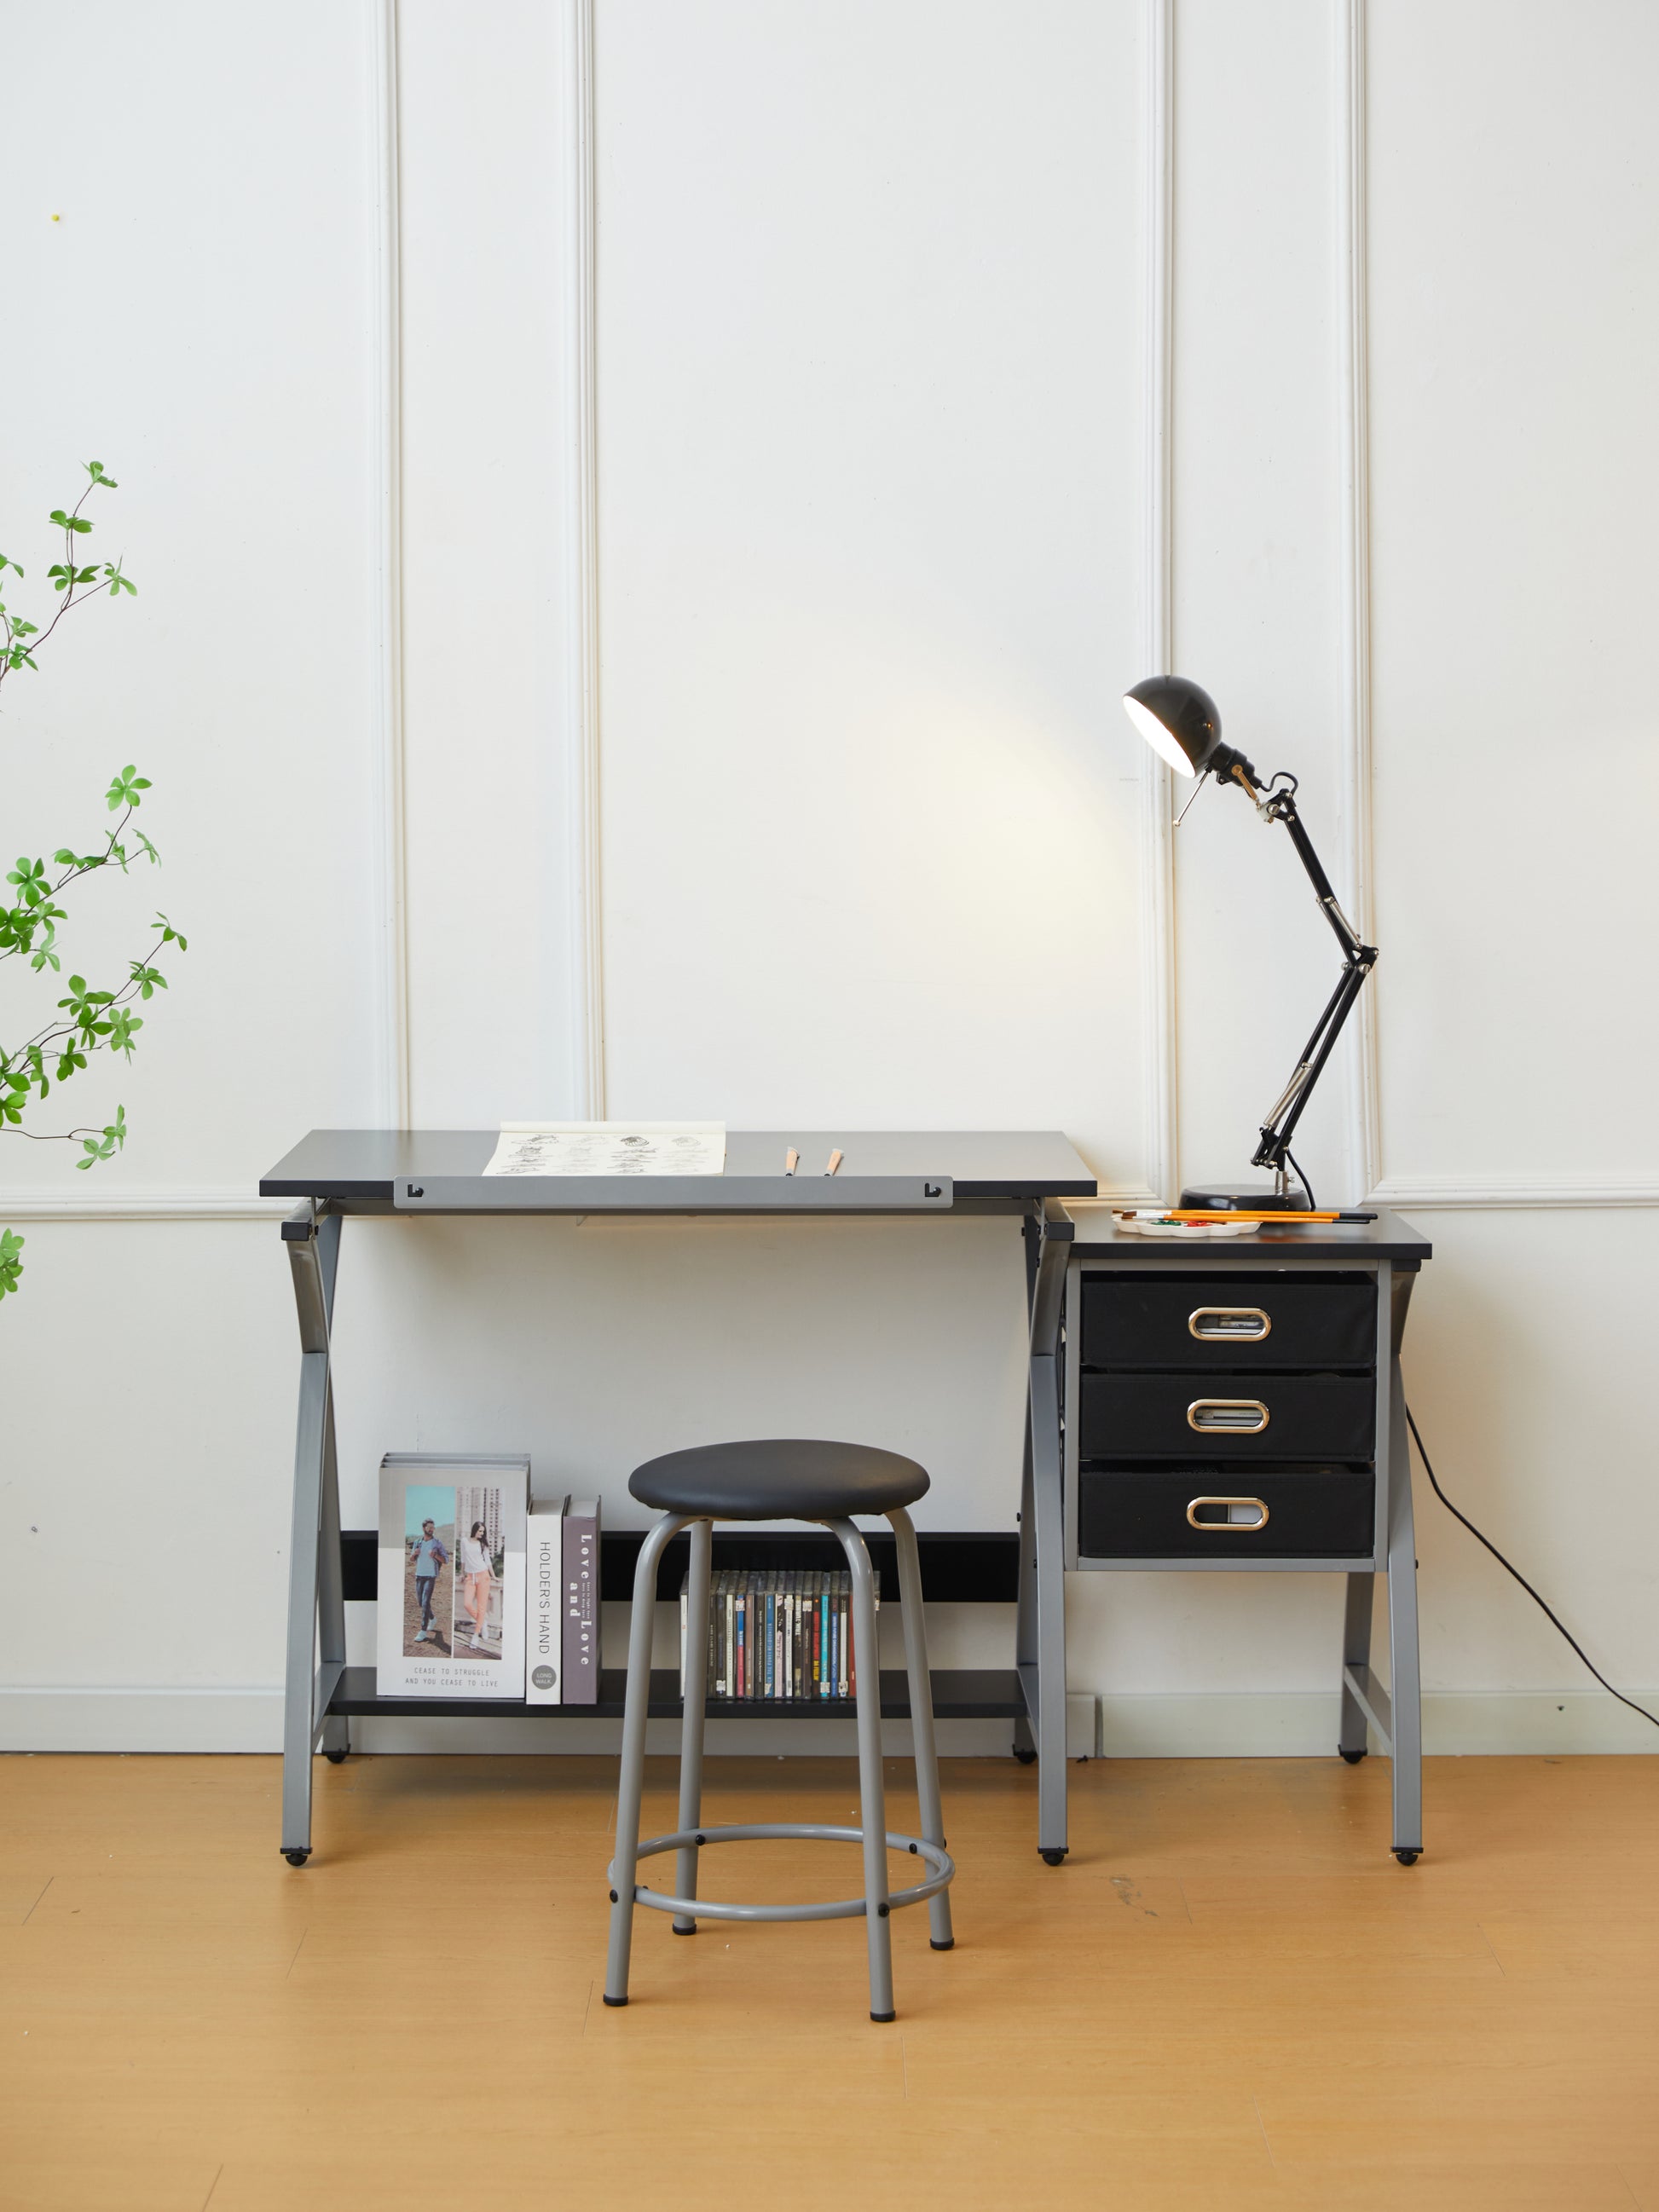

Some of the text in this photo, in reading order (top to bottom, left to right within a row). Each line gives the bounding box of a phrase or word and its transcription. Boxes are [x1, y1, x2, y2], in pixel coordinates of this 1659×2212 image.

[581, 1534, 592, 1579] Love
[539, 1542, 551, 1654] HOLDER'S HAND
[569, 1582, 581, 1616] and
[581, 1620, 592, 1665] Love
